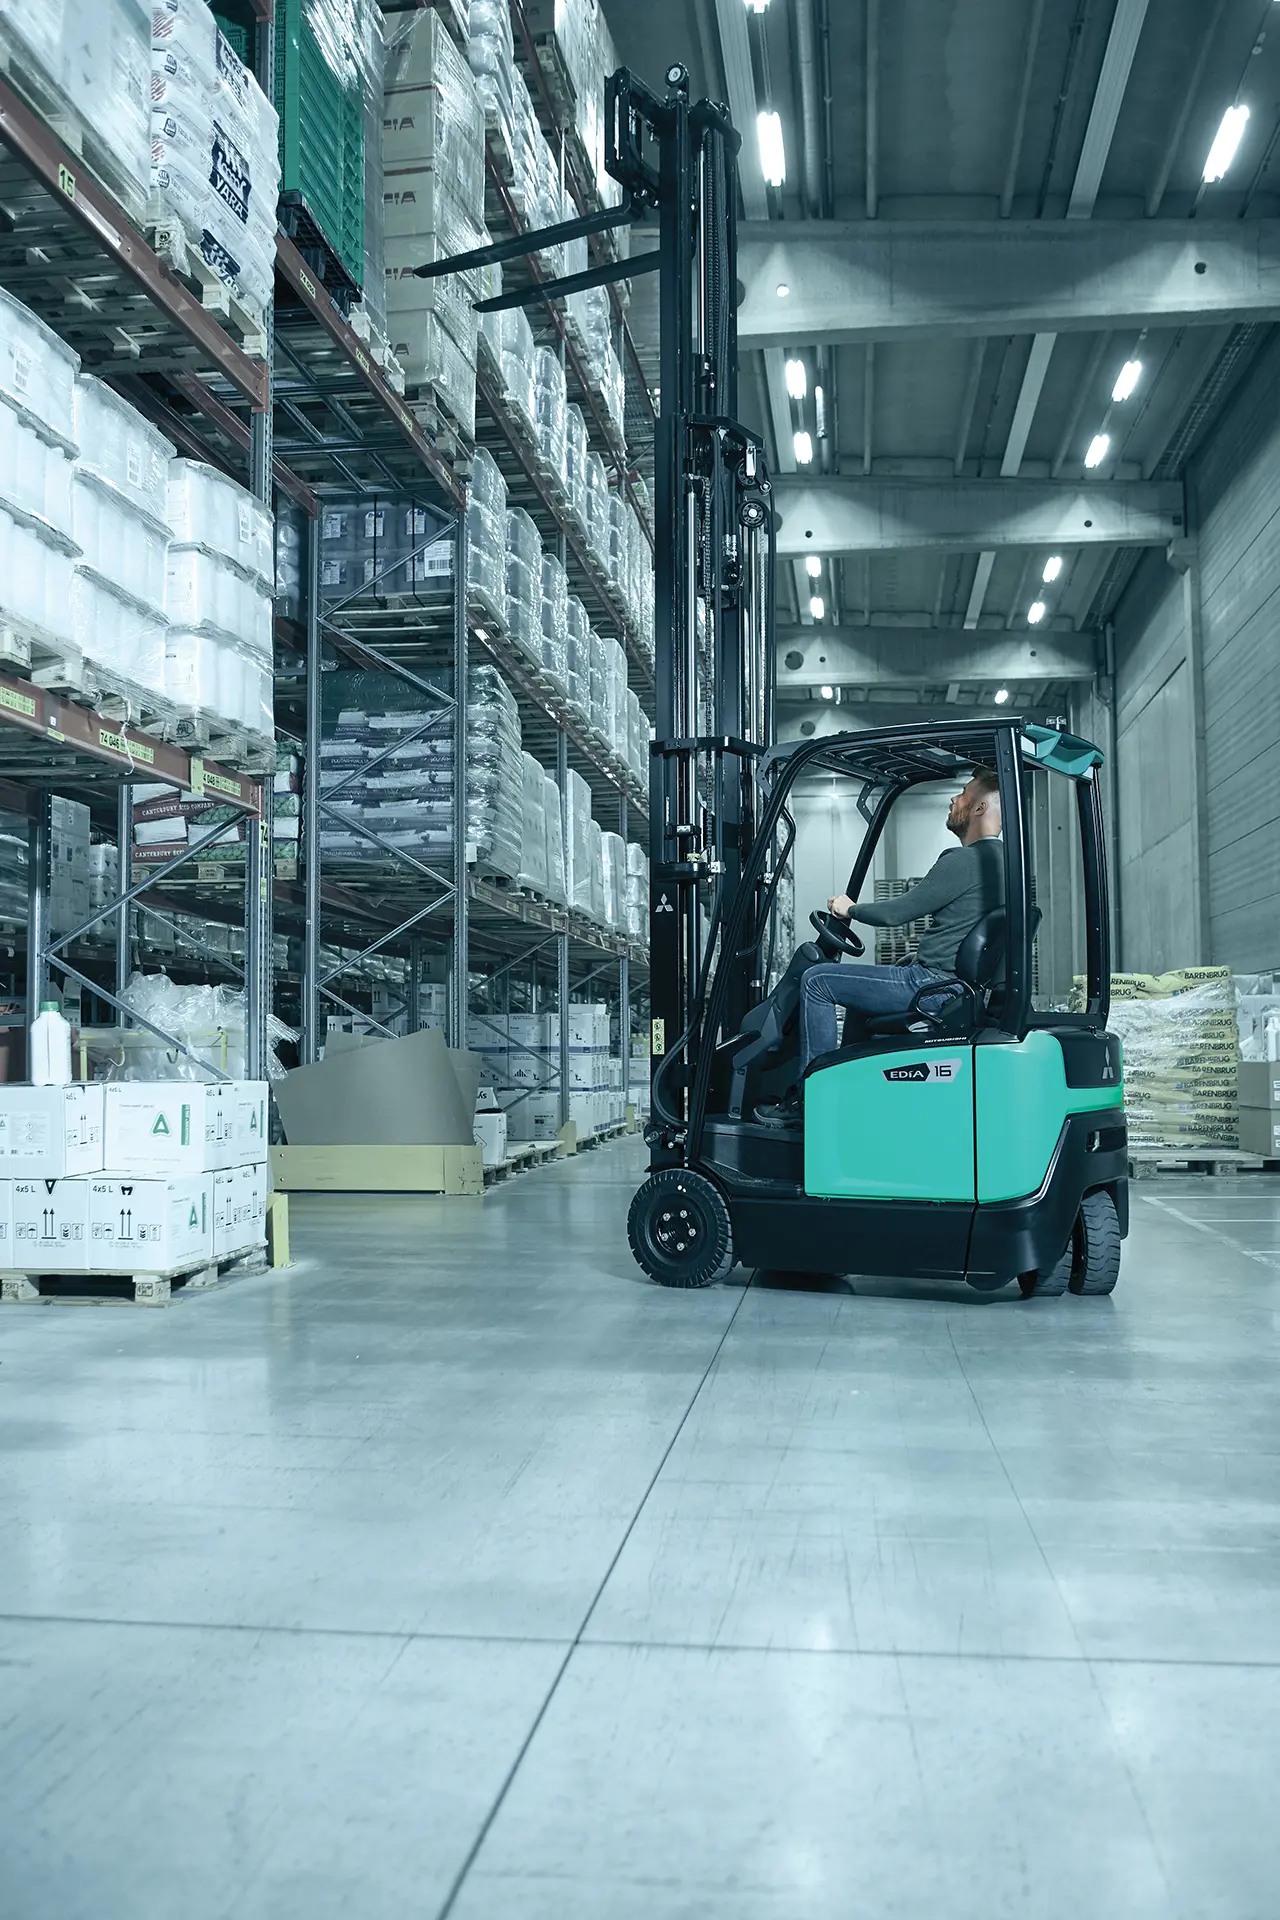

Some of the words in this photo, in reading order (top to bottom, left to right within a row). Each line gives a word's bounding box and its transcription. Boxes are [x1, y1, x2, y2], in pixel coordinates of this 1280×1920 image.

[60, 169, 74, 198] 15
[216, 175, 243, 218] YARA
[100, 732, 108, 741] 74
[142, 805, 177, 816] CANTERBURY
[190, 802, 215, 810] COMPANY
[260, 825, 269, 843] 74
[135, 850, 171, 858] CANTERBURY
[1184, 970, 1228, 979] BARENBRUG
[1111, 978, 1146, 988] RENBRUG
[1184, 1055, 1230, 1065] BARENBRUG
[935, 1065, 951, 1077] 16
[1192, 1066, 1236, 1074] BARENBRUG
[1184, 1079, 1229, 1088] BARENBRUG
[1192, 1090, 1237, 1098] BARENBRUG
[1187, 1102, 1232, 1110] BARENBRUG
[1195, 1114, 1239, 1124] BARENBRUG
[1188, 1124, 1233, 1132] BARENBRUG
[15, 1185, 29, 1193] 4x5
[92, 1185, 107, 1193] 4x5
